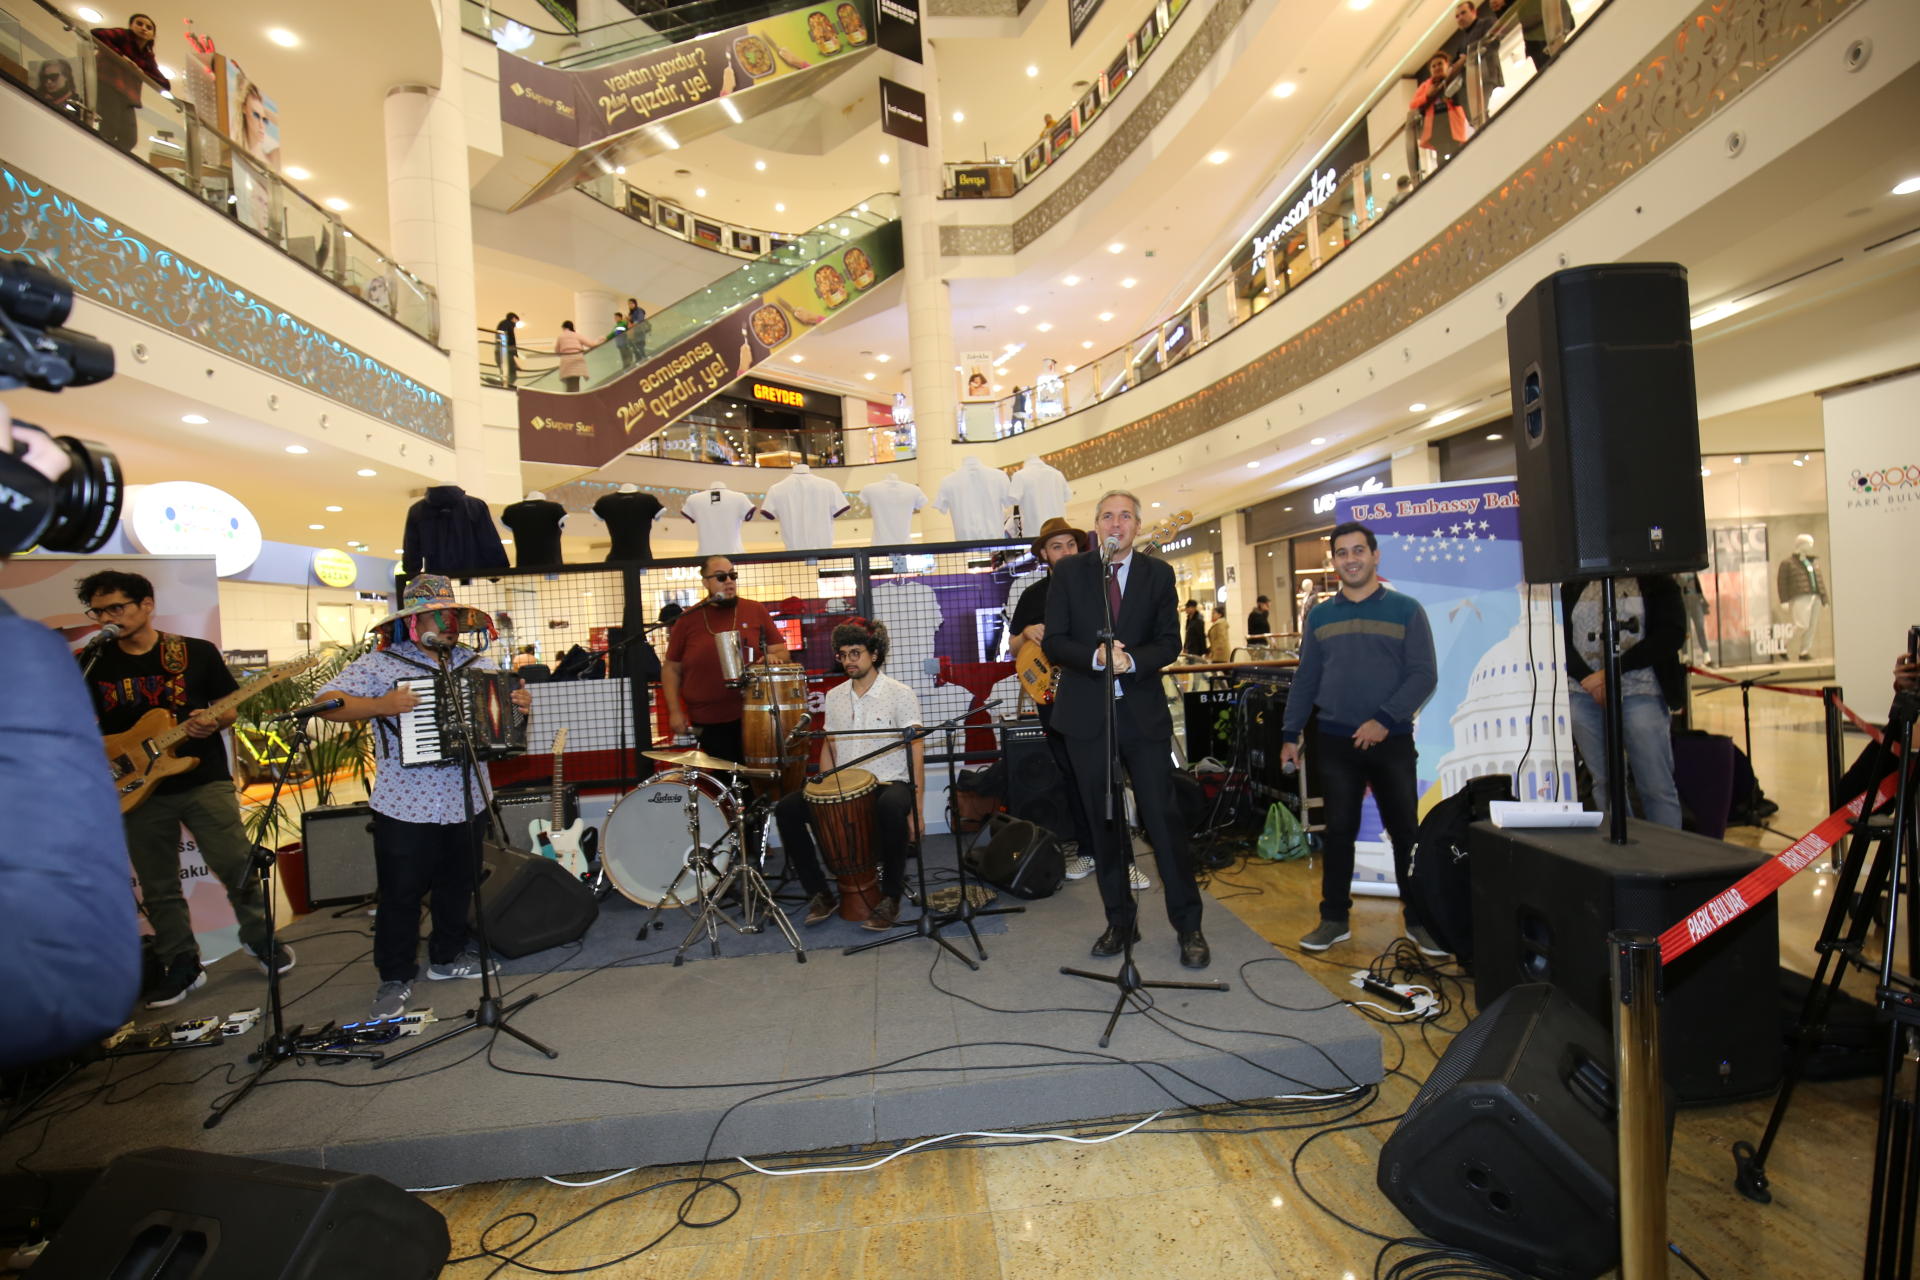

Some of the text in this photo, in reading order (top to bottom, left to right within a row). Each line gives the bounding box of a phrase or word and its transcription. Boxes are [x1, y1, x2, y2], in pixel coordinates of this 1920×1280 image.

[652, 47, 707, 84] yoxdur?
[682, 69, 711, 101] ye!
[703, 353, 729, 389] ye!
[754, 384, 804, 407] GREYDER
[1352, 503, 1391, 521] U.S.
[1396, 495, 1480, 517] Embassy
[1847, 495, 1879, 509] PARK
[1750, 623, 1794, 642] THE BIG
[1756, 639, 1788, 655] CHILL
[648, 791, 683, 804] Ludwig
[1778, 832, 1830, 873] PARK BULVAR
[1687, 888, 1749, 943] PARK BULVAR
